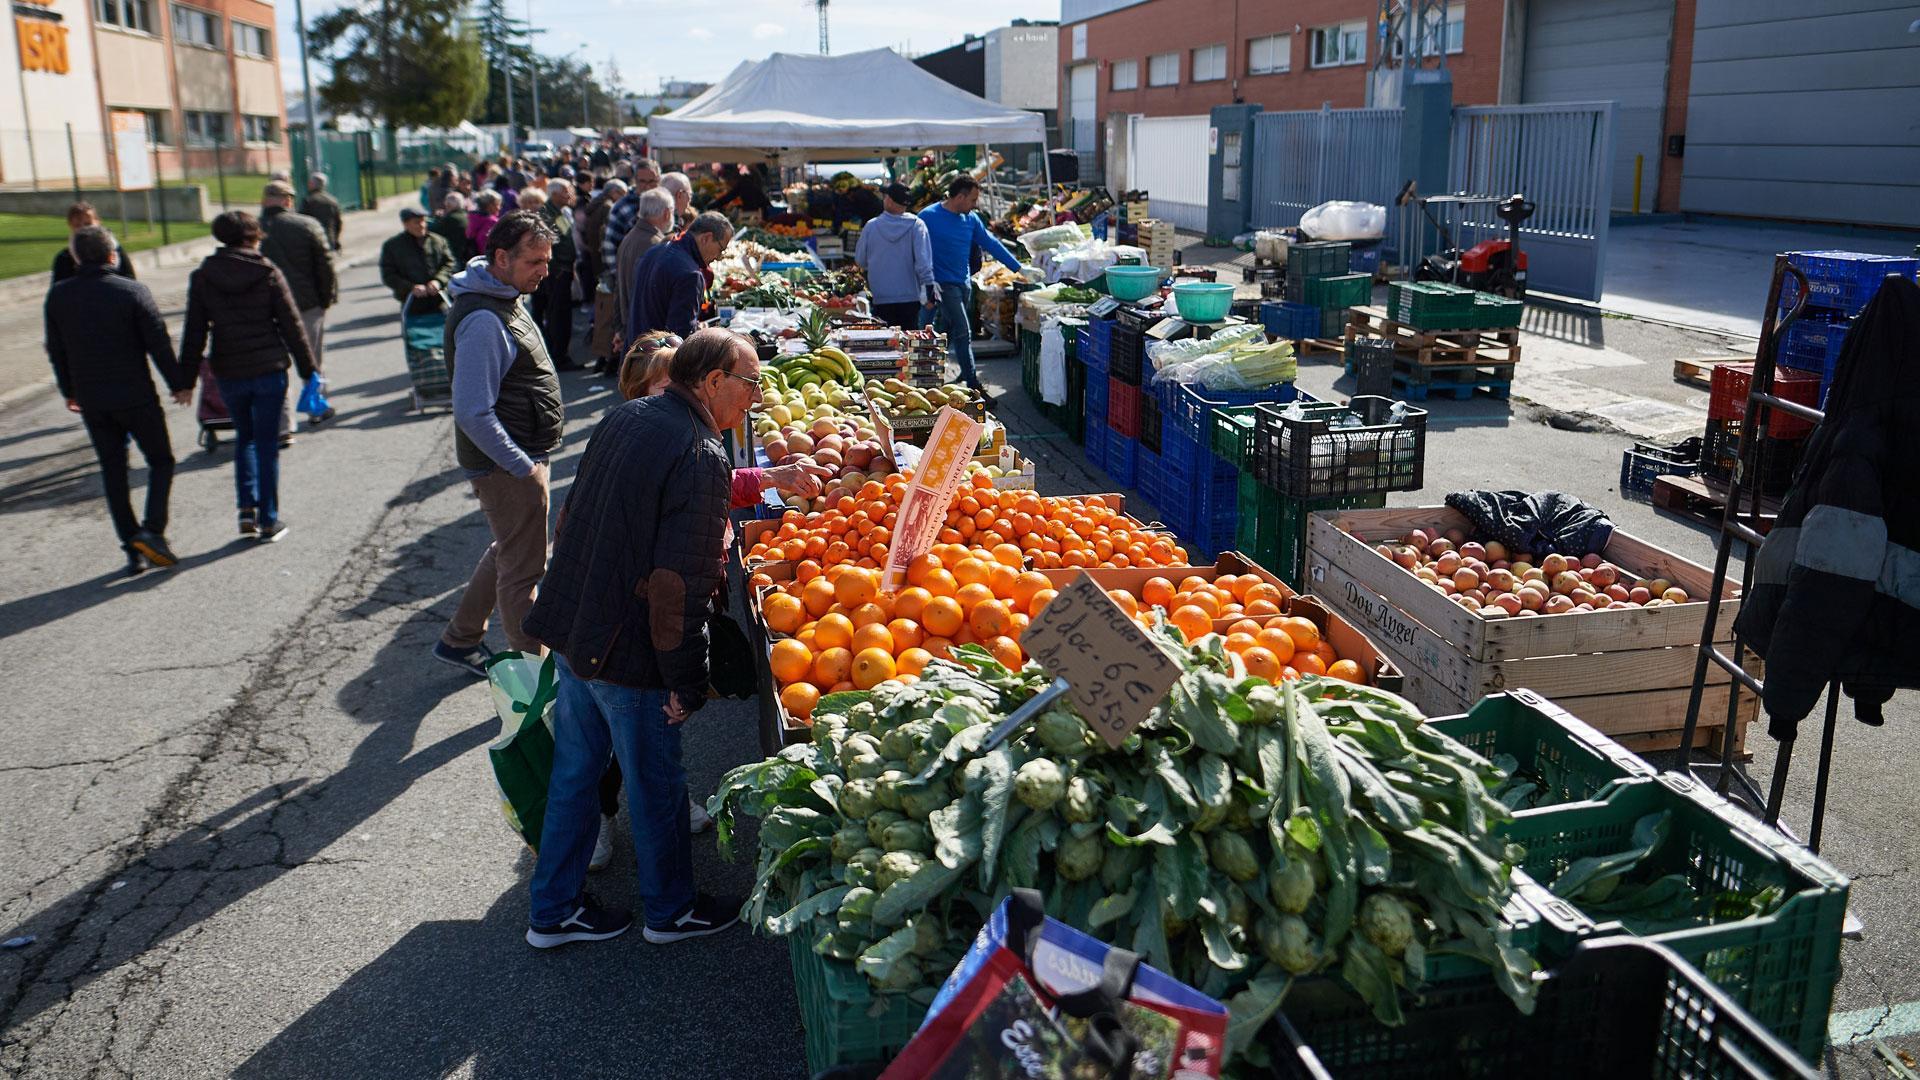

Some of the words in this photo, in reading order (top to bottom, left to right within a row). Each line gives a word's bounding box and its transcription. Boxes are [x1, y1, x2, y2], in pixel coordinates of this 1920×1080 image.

[943, 443, 973, 501] LLORENTE
[1022, 628, 1043, 644] 1
[1043, 597, 1072, 624] 2
[1075, 582, 1168, 672] ALCACHOFA
[1345, 581, 1373, 615] Don
[1375, 604, 1419, 645] Angel
